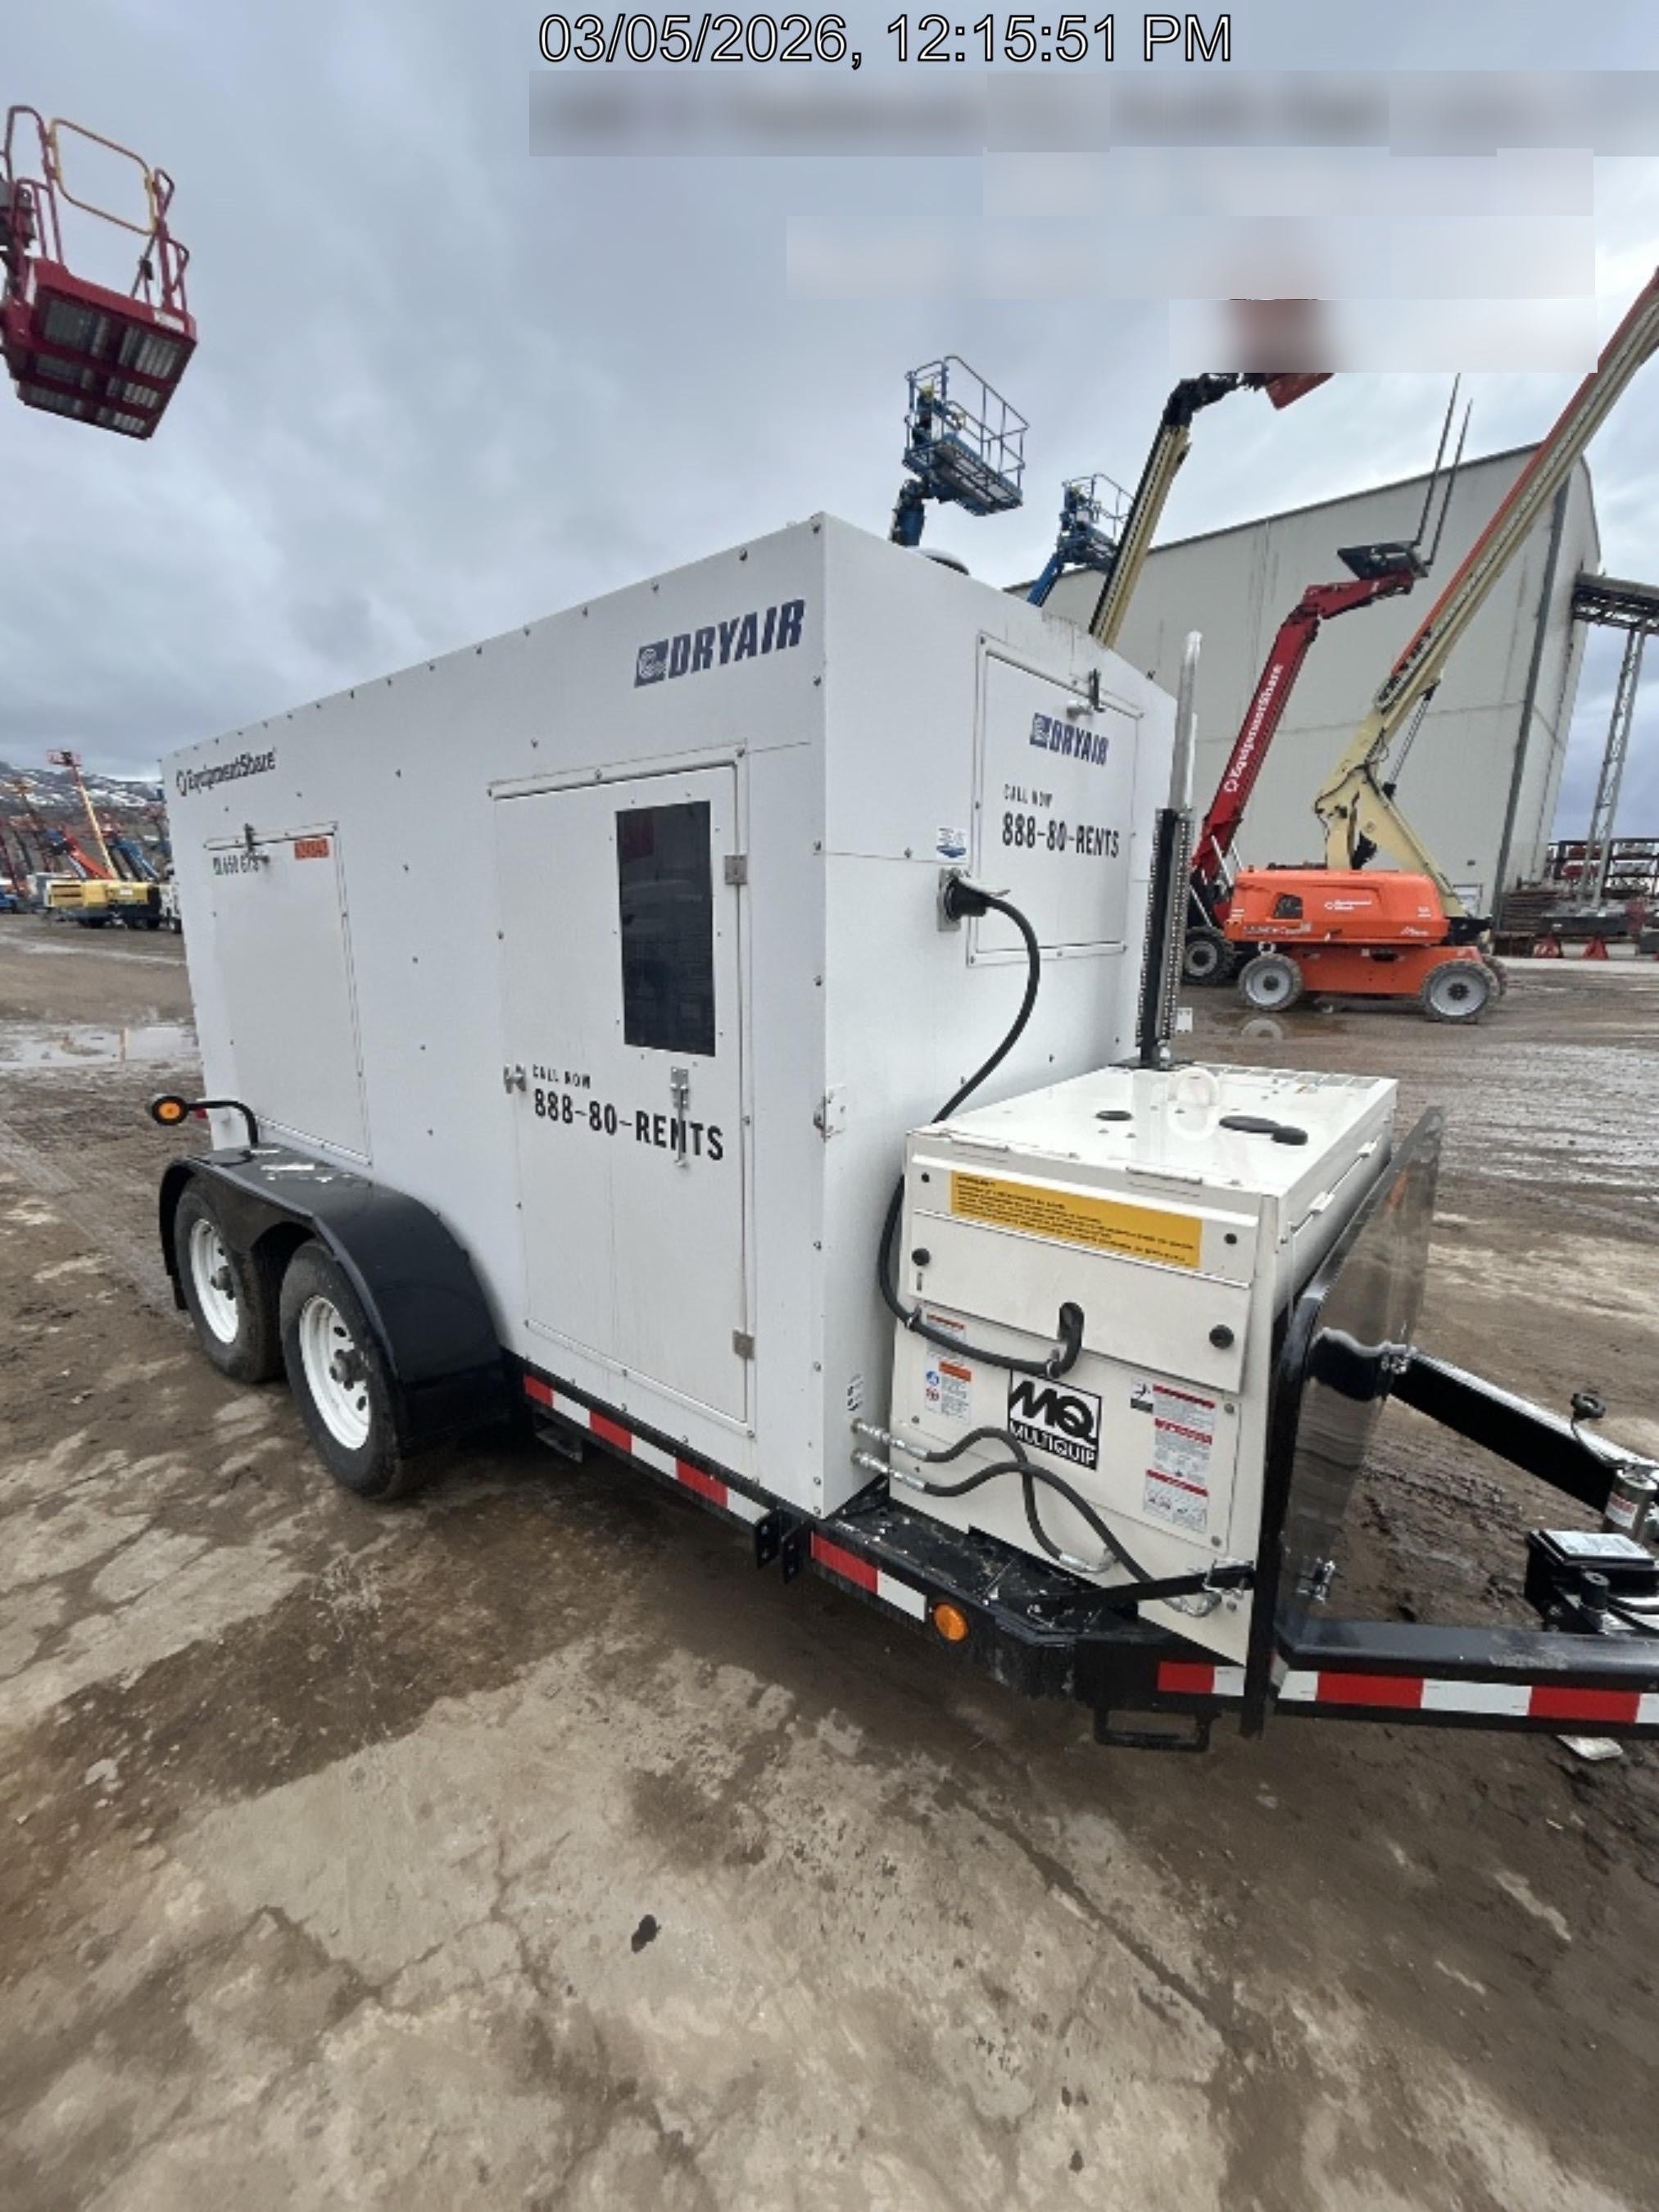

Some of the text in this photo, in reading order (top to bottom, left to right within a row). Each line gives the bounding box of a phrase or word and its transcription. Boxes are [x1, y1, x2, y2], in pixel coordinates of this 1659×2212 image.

[668, 599, 805, 679] DRYAIR
[1049, 720, 1108, 766] DRYAIR
[1004, 784, 1053, 808] CALL NOW
[1002, 811, 1119, 858] 888-80-RENTS
[533, 1064, 591, 1089] CALL NOW
[534, 1088, 723, 1161] 888-80-RENTS
[1009, 1380, 1096, 1441] MQ
[1009, 1419, 1096, 1466] MULTIQUIP
